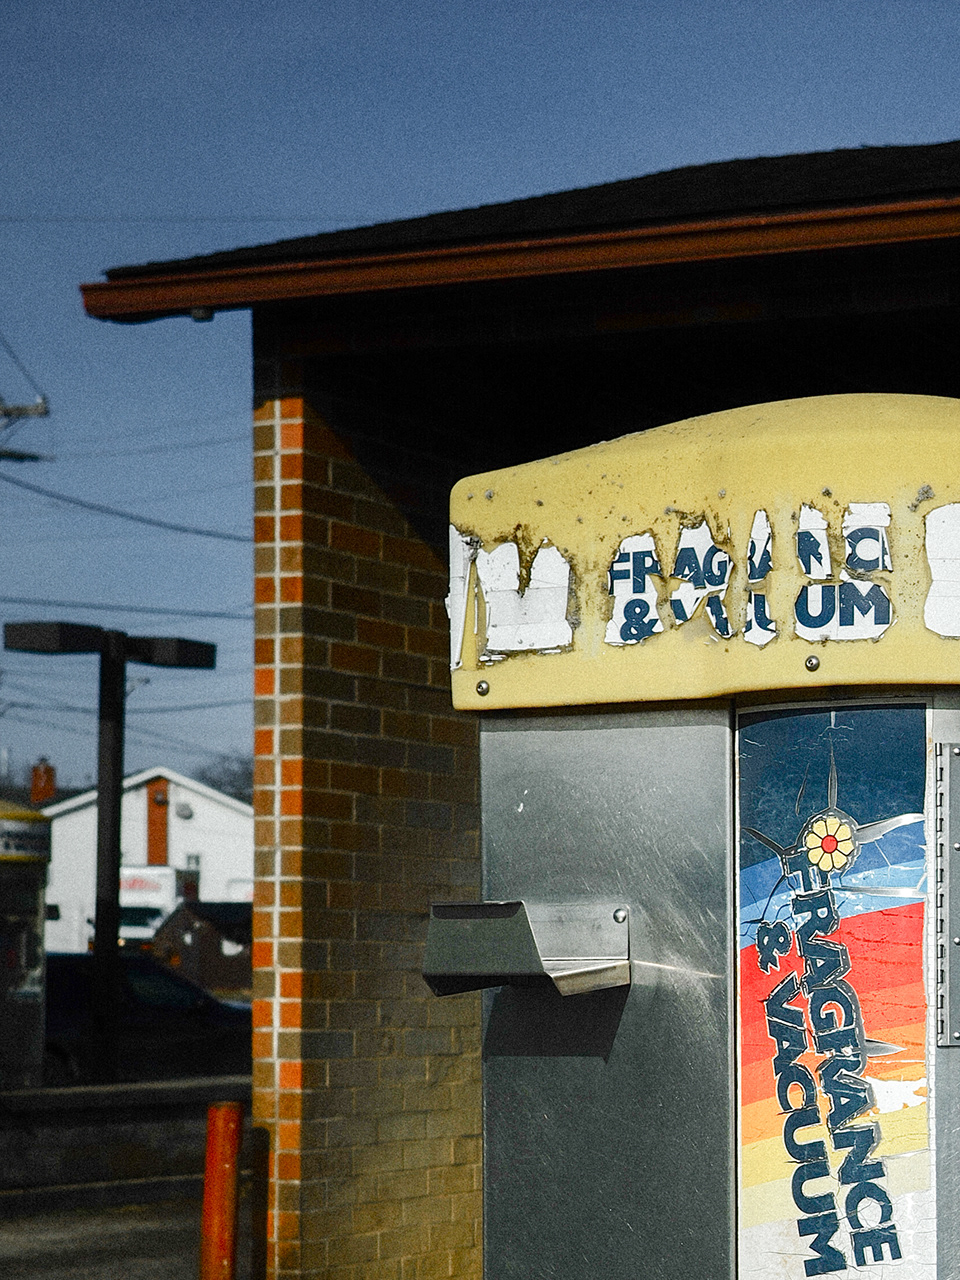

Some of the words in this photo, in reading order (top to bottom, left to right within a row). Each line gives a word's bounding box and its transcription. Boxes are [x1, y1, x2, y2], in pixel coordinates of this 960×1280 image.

[619, 598, 660, 642] &
[755, 920, 791, 974] &
[764, 972, 848, 1278] VACUUM
[785, 850, 902, 1267] FRAGRANCE
